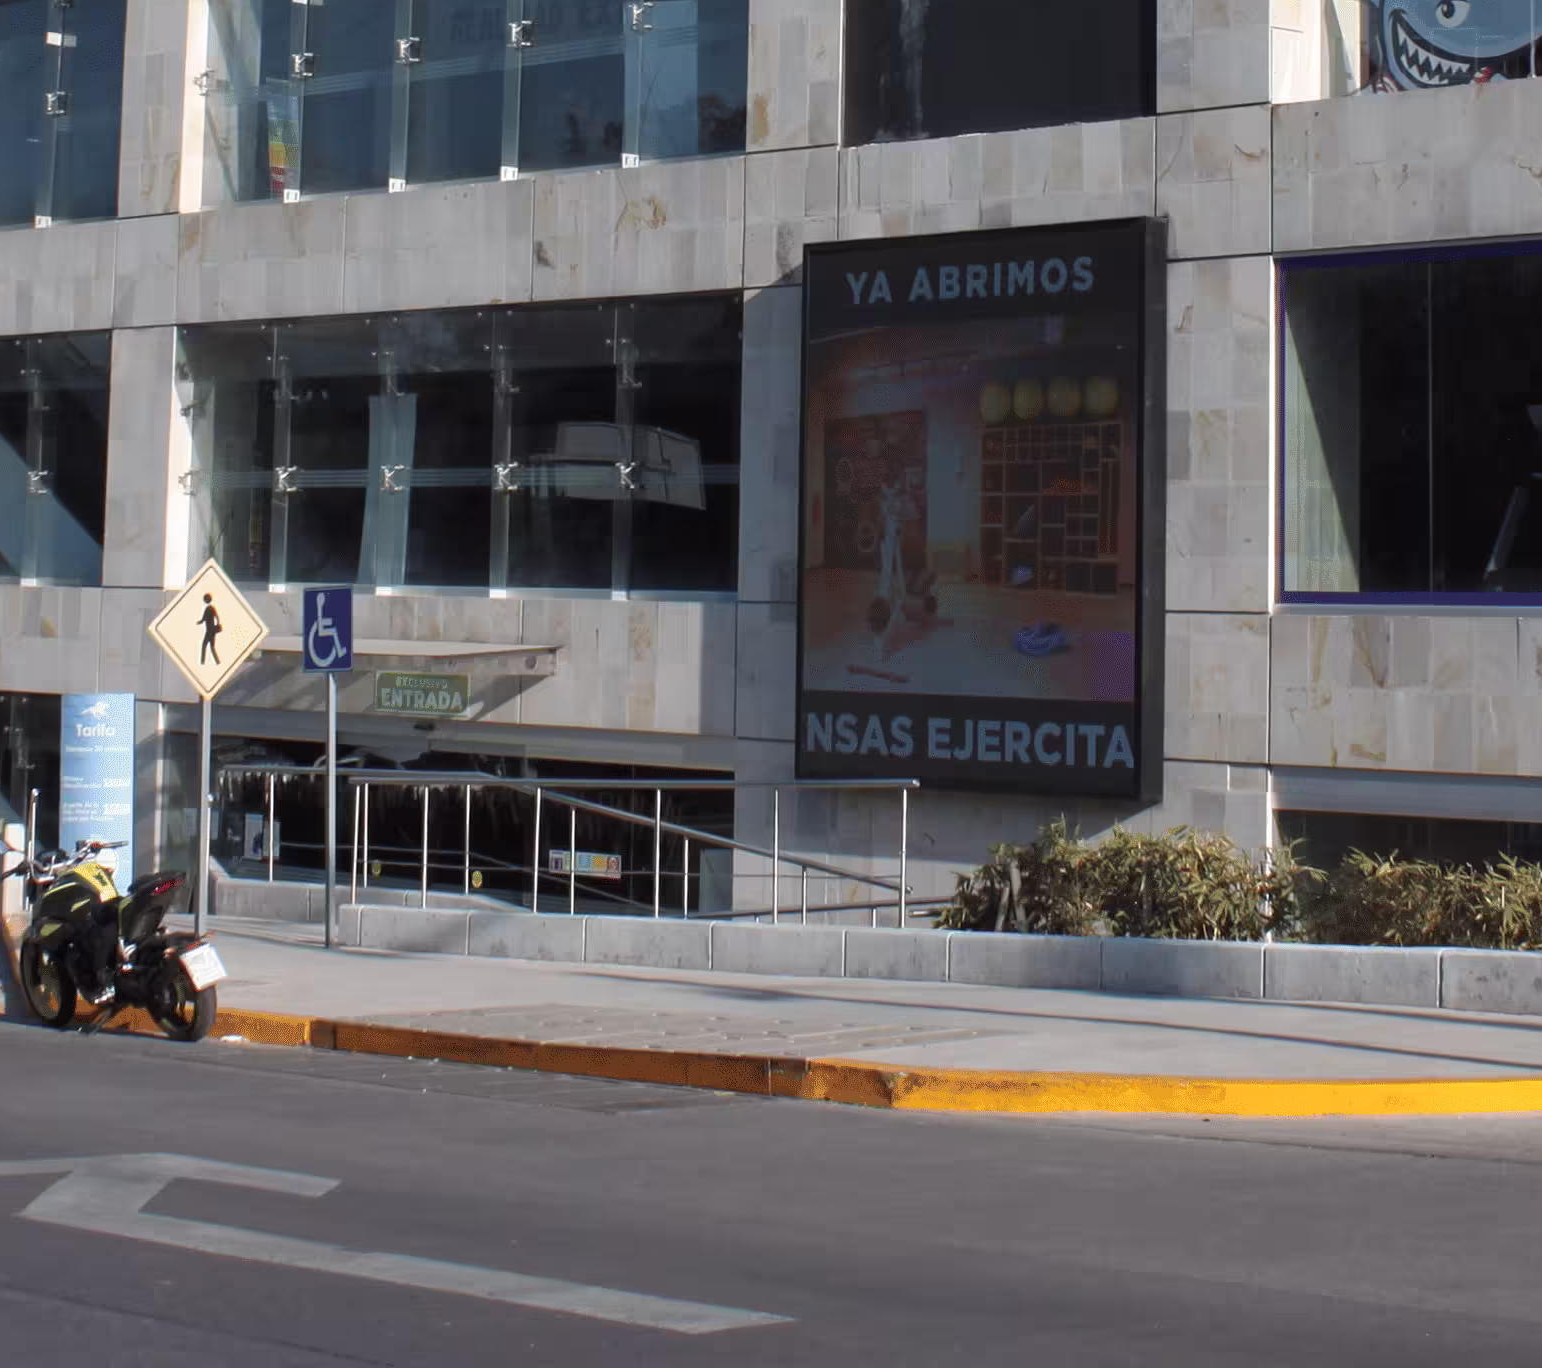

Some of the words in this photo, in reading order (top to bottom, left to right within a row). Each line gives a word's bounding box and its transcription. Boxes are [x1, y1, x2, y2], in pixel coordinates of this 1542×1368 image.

[845, 271, 892, 305] YA
[908, 255, 1095, 303] ABRIMOS
[380, 687, 464, 711] ENTRADA
[805, 711, 915, 758] NSAS
[927, 715, 1135, 769] EJERCITA
